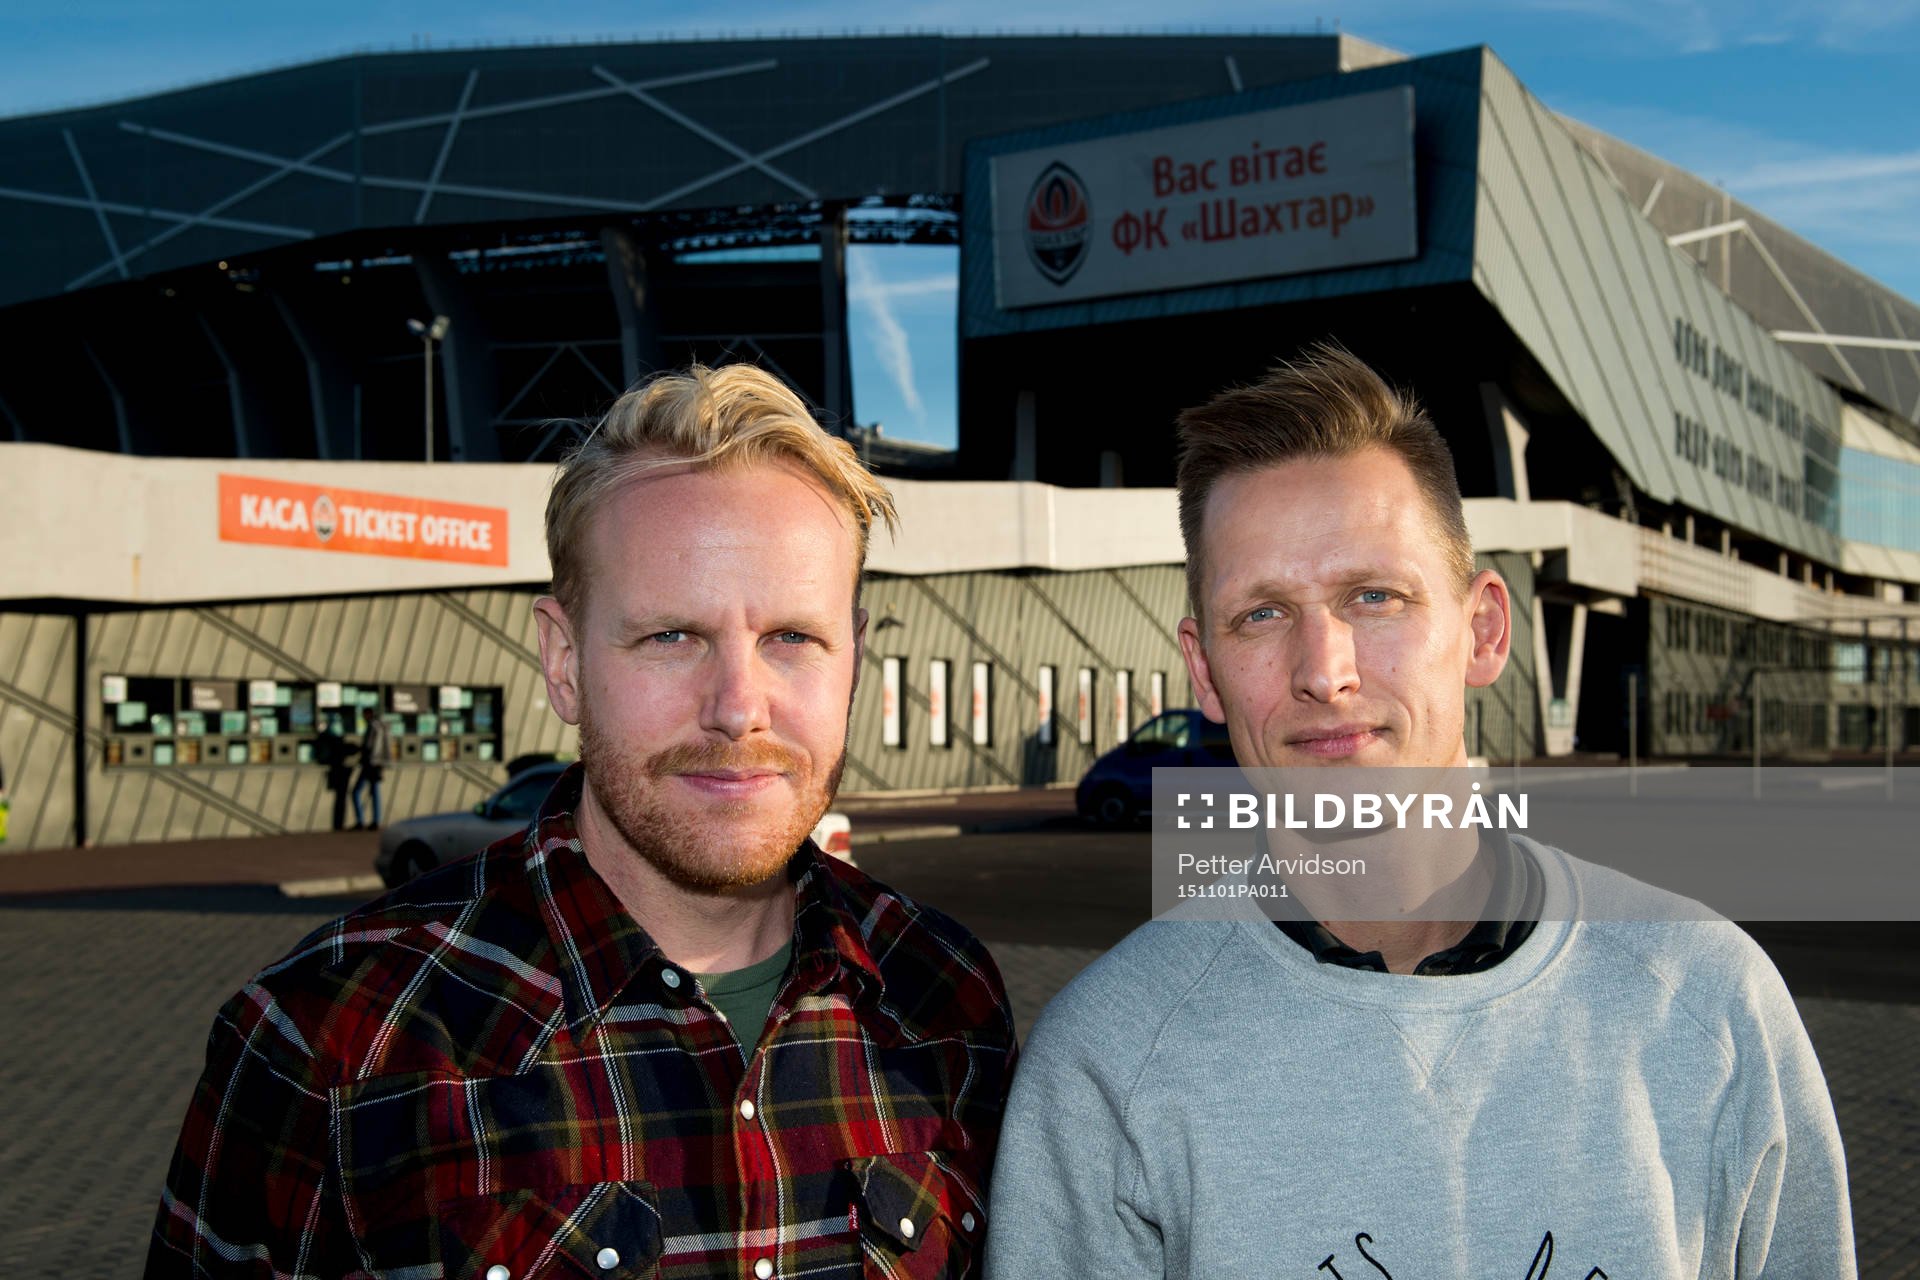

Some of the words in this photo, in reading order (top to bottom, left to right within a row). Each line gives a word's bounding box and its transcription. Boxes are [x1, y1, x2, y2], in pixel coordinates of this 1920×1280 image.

[1153, 154, 1218, 197] Вас
[1229, 141, 1328, 187] вітає
[1111, 207, 1170, 256] ФК
[1181, 192, 1375, 240] «Шахтар»
[240, 494, 310, 532] КАСА
[339, 505, 417, 542] TICKET
[421, 515, 493, 550] OFFICE
